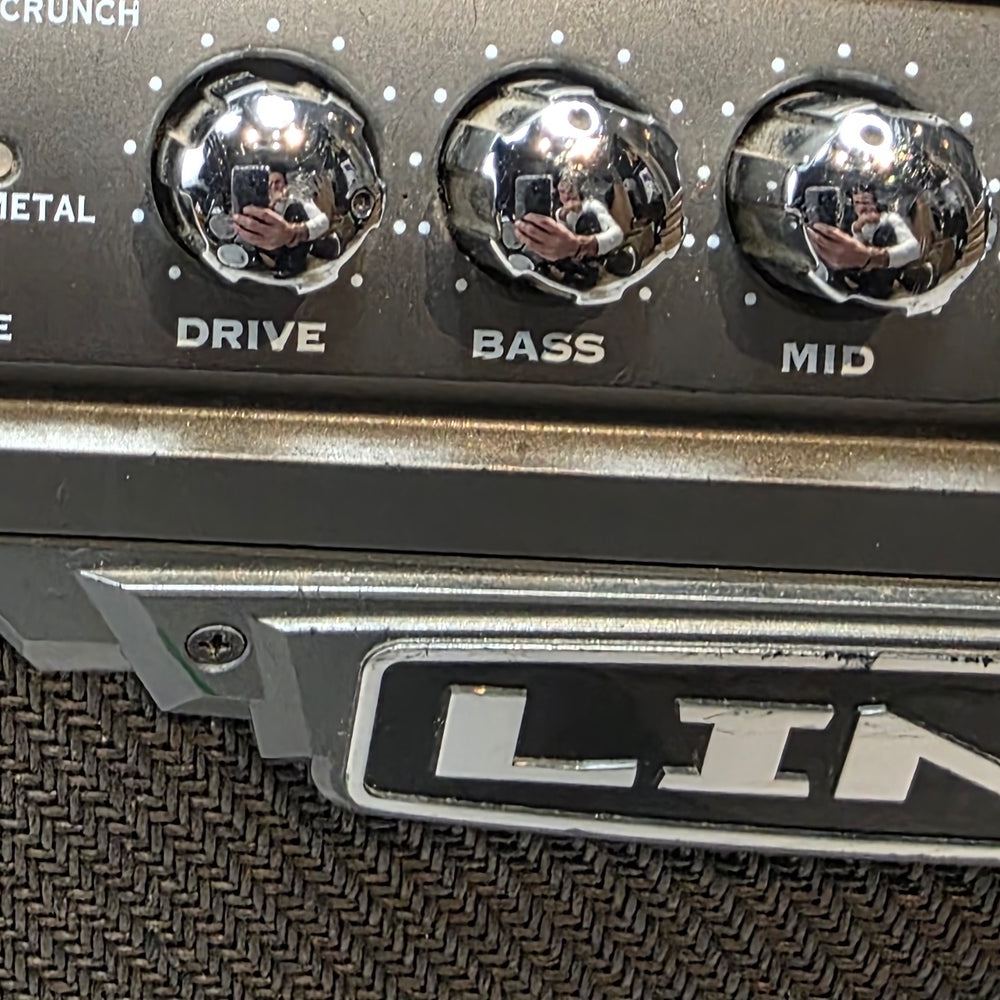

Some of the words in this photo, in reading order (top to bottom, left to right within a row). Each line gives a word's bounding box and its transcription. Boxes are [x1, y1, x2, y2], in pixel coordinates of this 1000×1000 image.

[175, 317, 328, 354] DRIVE
[471, 328, 607, 365] BASS
[780, 341, 876, 376] MID
